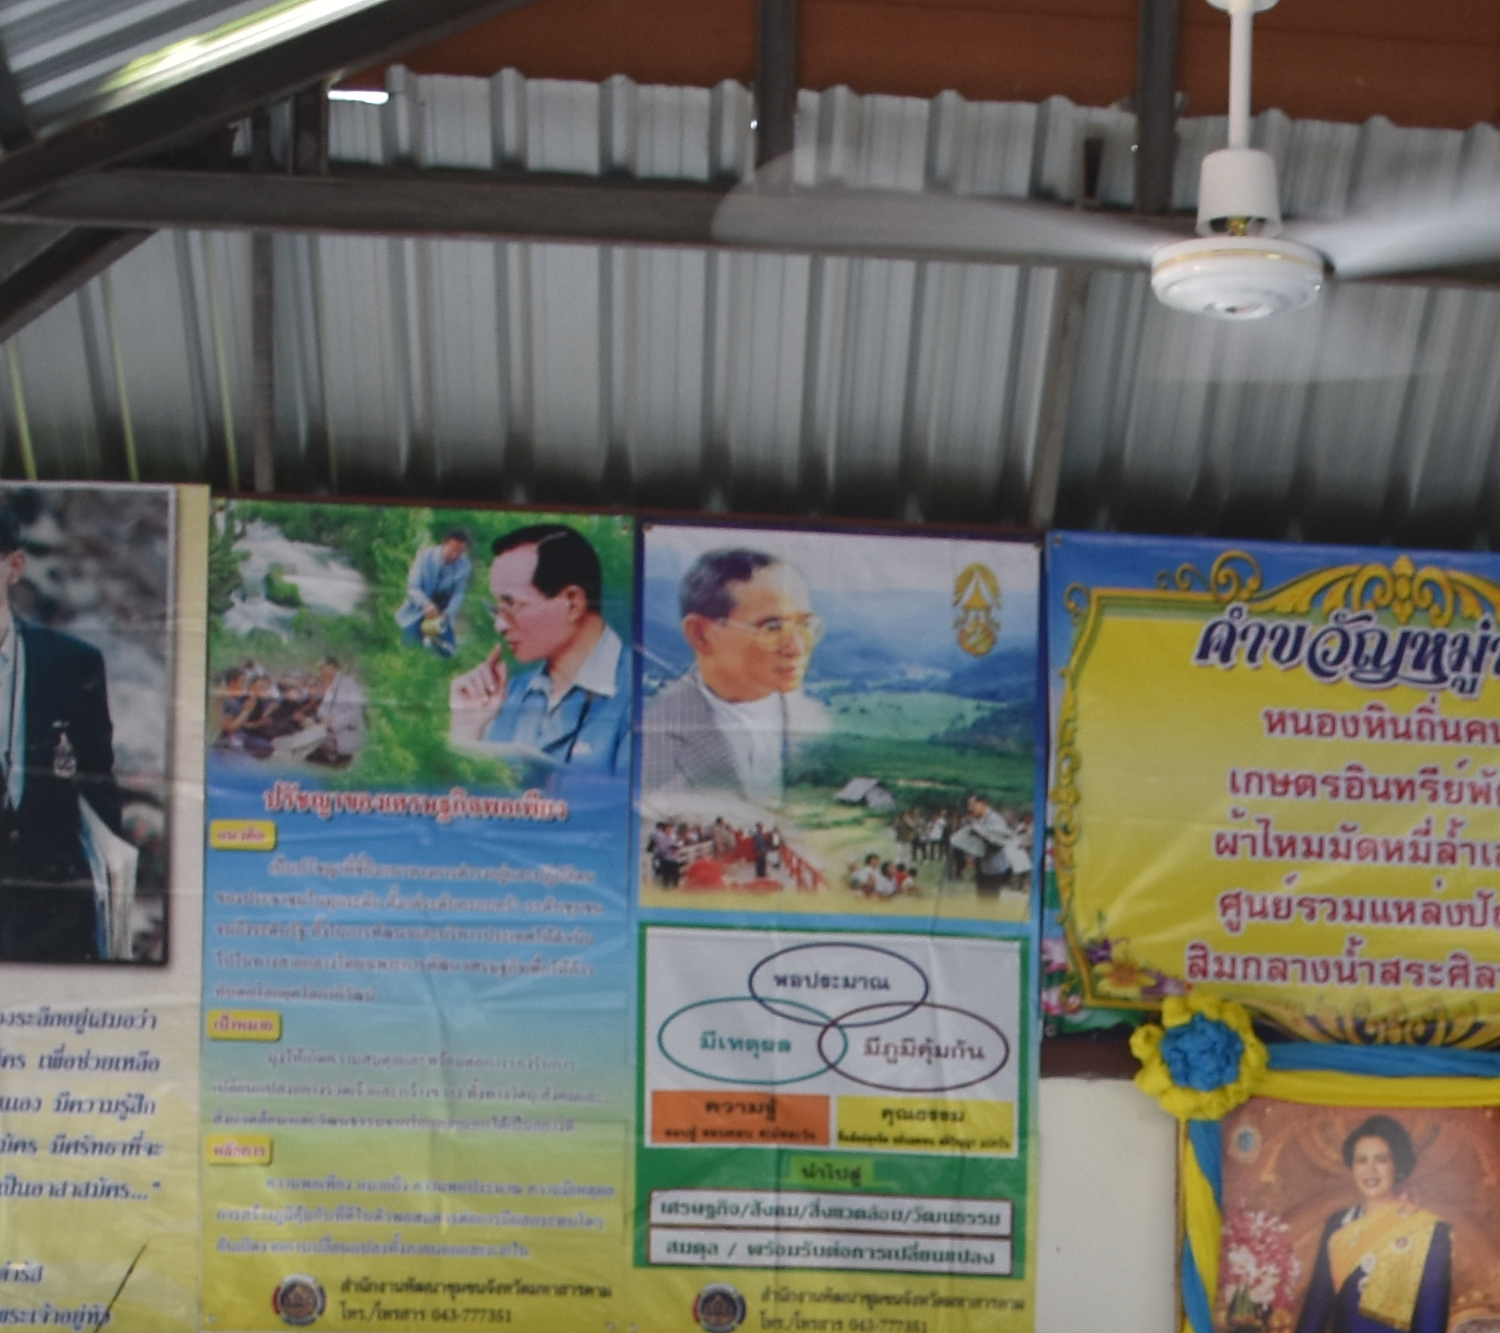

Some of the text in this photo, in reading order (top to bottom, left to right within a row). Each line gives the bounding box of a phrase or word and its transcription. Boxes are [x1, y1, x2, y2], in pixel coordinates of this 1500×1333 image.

[773, 973, 891, 992] พอประมาณ
[699, 1030, 793, 1054] มีเหตุผล
[863, 1037, 986, 1065] มีภูมิคุ้มกัน
